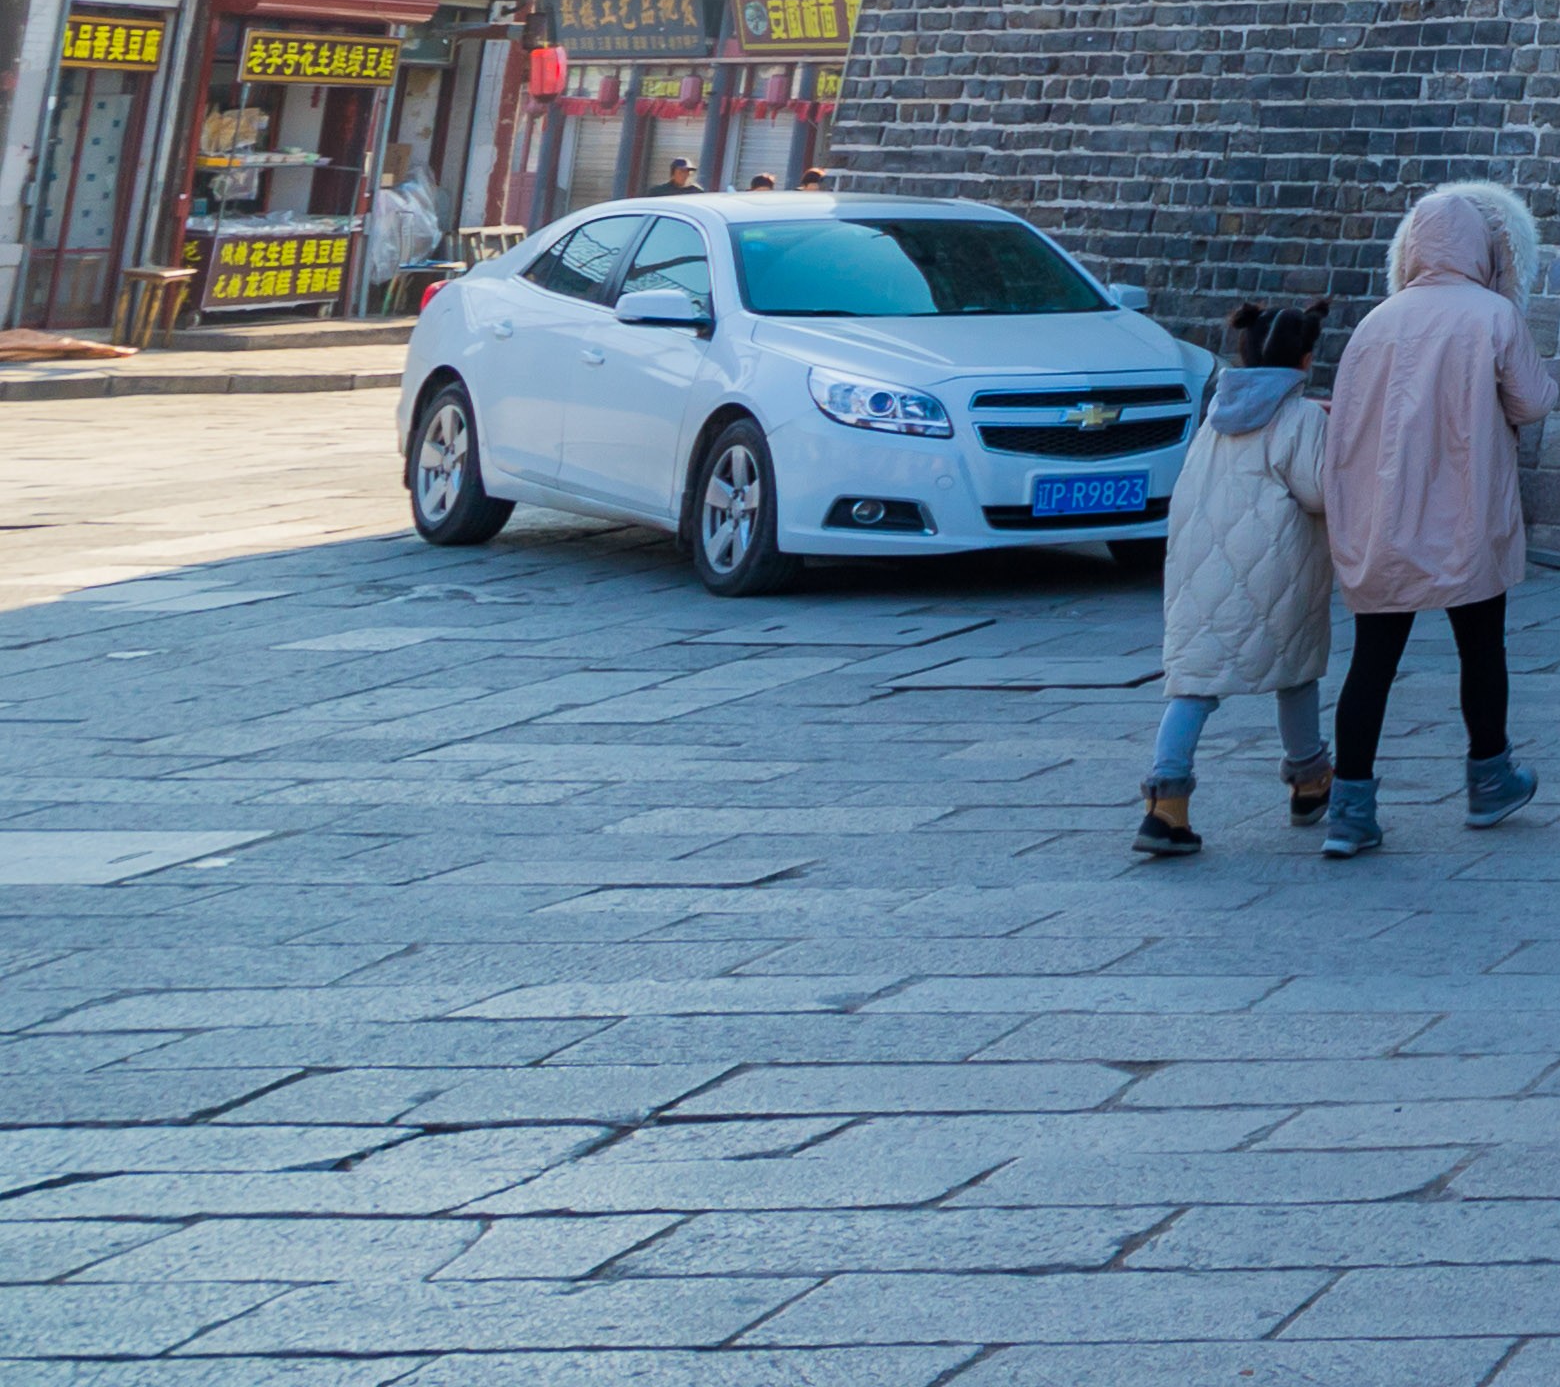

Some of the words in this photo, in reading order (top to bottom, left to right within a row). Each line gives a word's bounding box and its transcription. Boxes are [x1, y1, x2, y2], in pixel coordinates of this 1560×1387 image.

[247, 38, 396, 78] 老字号花生糕绿豆糕
